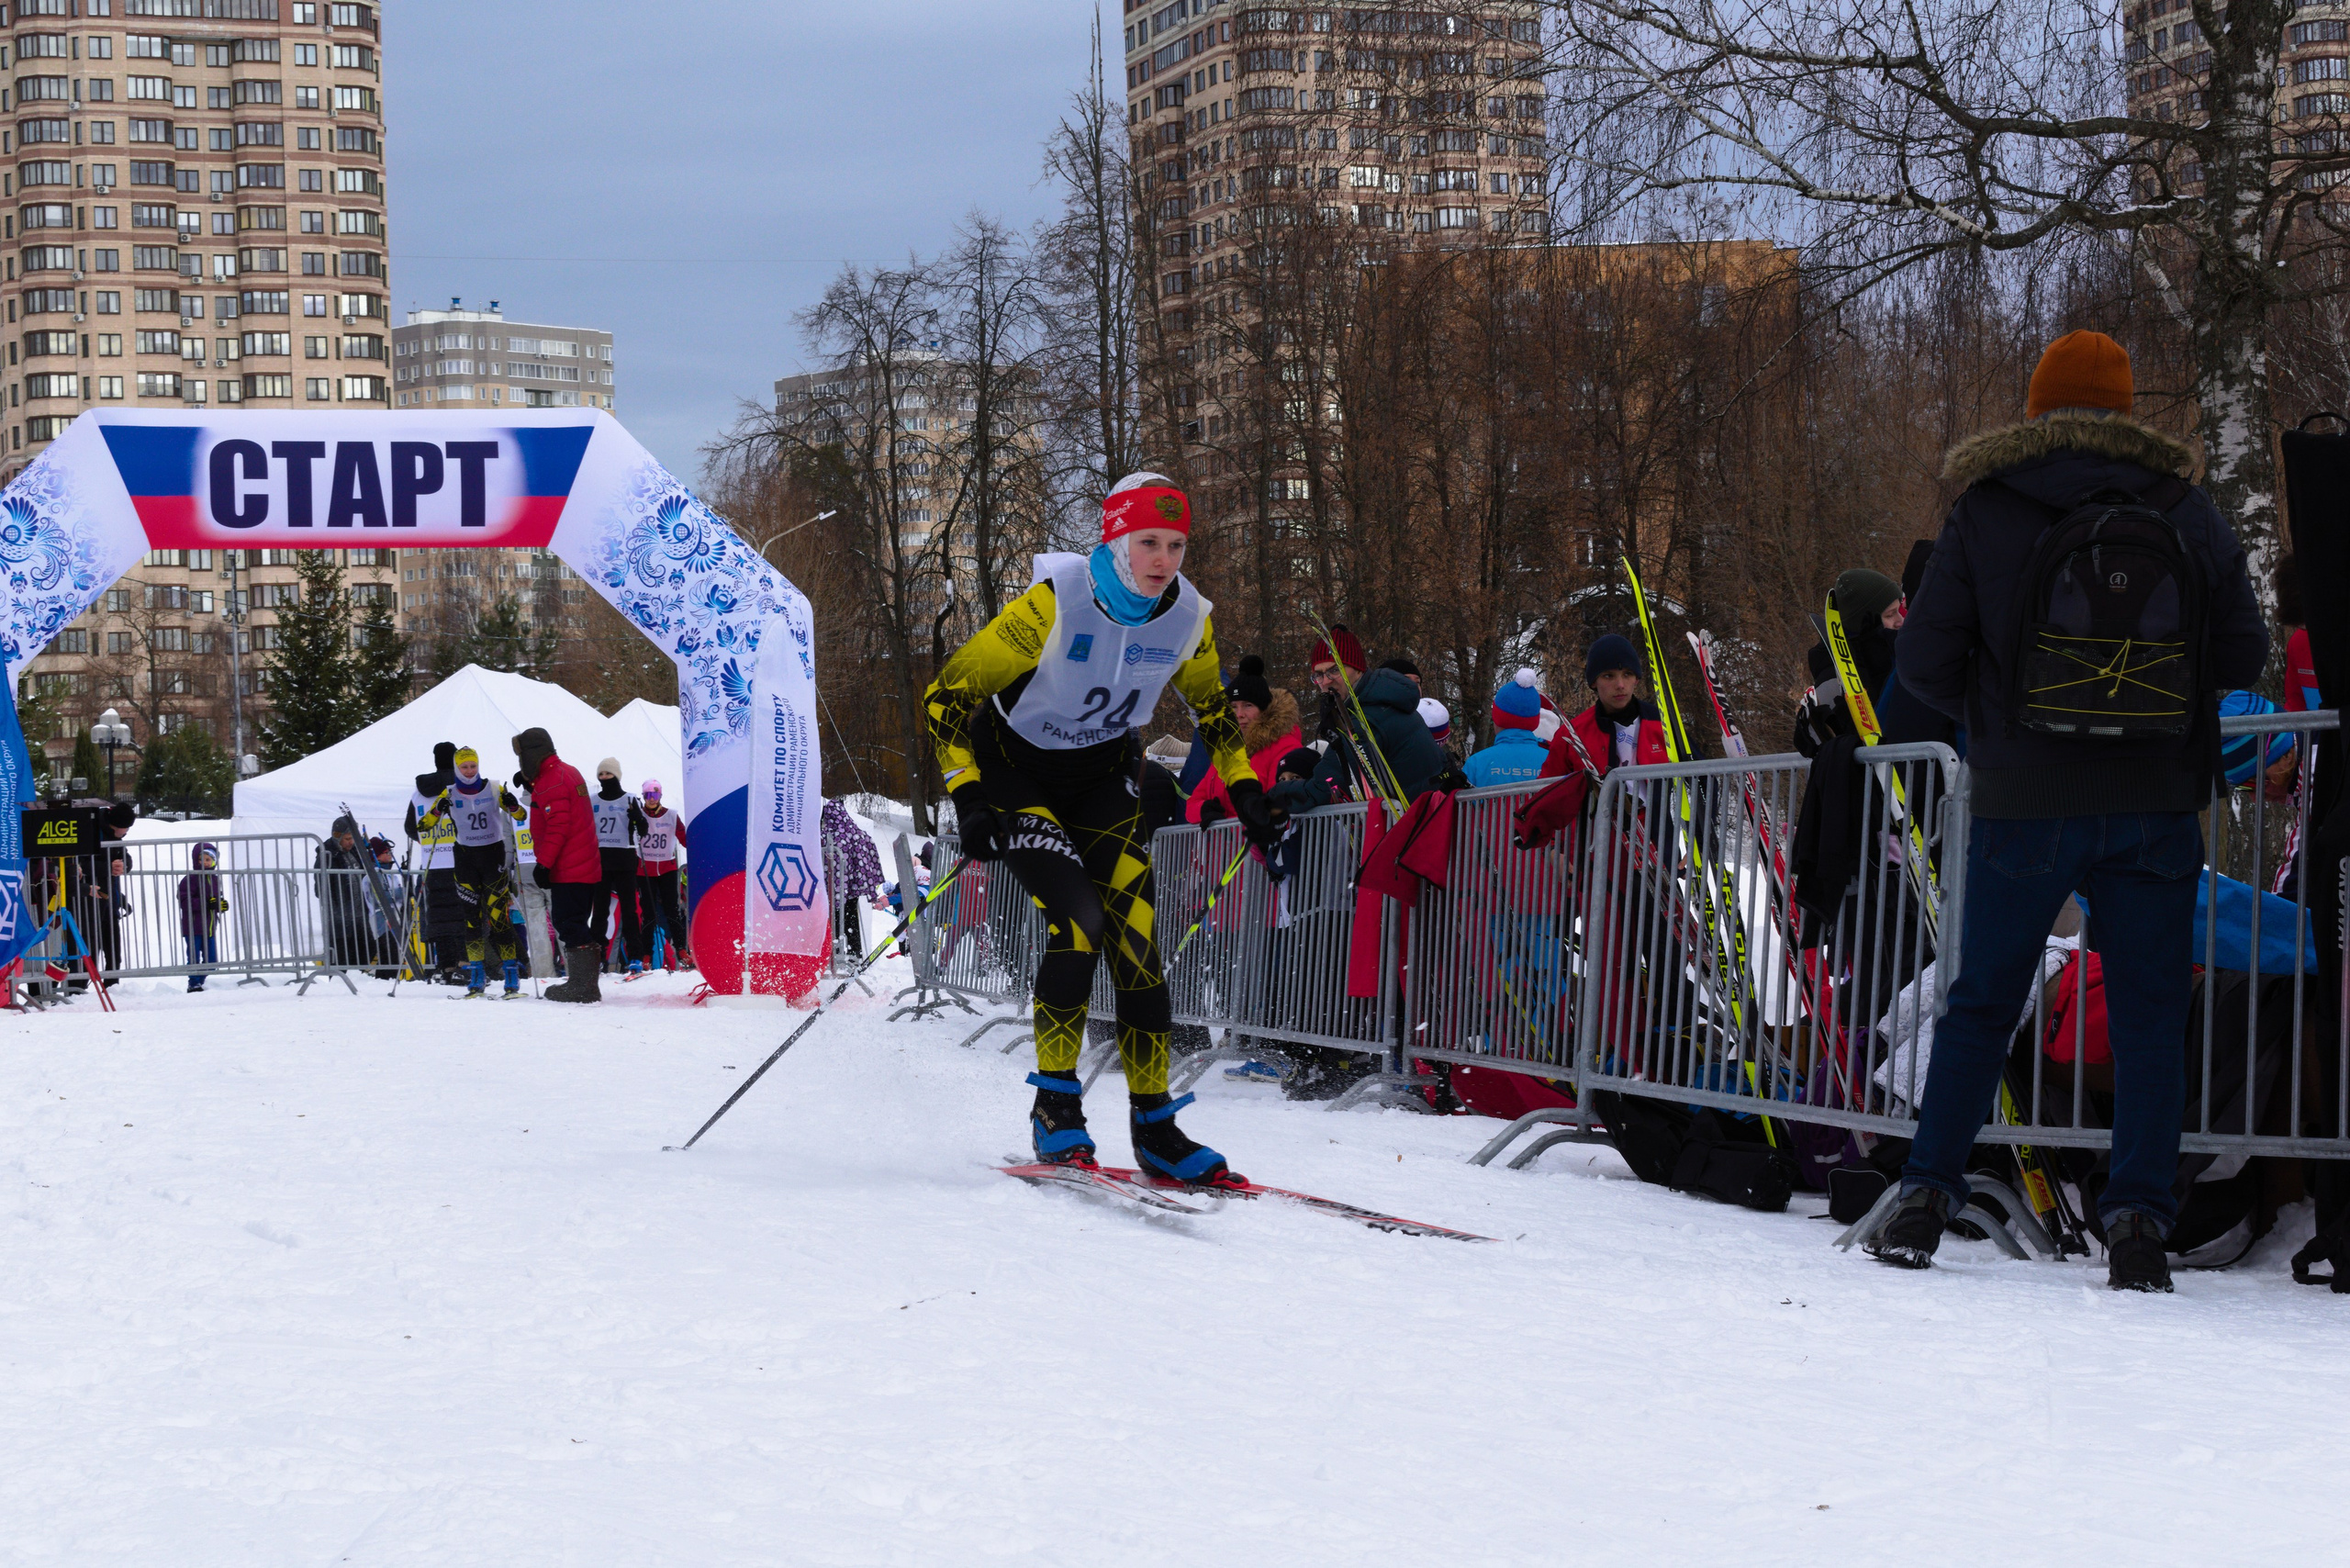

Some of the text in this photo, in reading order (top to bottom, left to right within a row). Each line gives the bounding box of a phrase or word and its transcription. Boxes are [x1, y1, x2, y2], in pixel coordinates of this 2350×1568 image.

[209, 439, 499, 528] СТАРТ
[1074, 687, 1141, 728] 24
[771, 693, 787, 833] КОМИТЕТ ПО СПОРТУ
[782, 698, 798, 834] АДМИНИСТРАЦИИ РАМЕНСКОГО
[796, 715, 809, 834] МУНИЦИПАЛЬНОГО ОКРУГА
[0, 778, 9, 860] АДМИНИСТРАЦИИ
[7, 772, 19, 860] МУНИЦИПАЛЬНОГО
[38, 820, 78, 837] ALGE
[467, 812, 487, 830] 26
[599, 817, 616, 834] 27
[643, 834, 667, 849] 236
